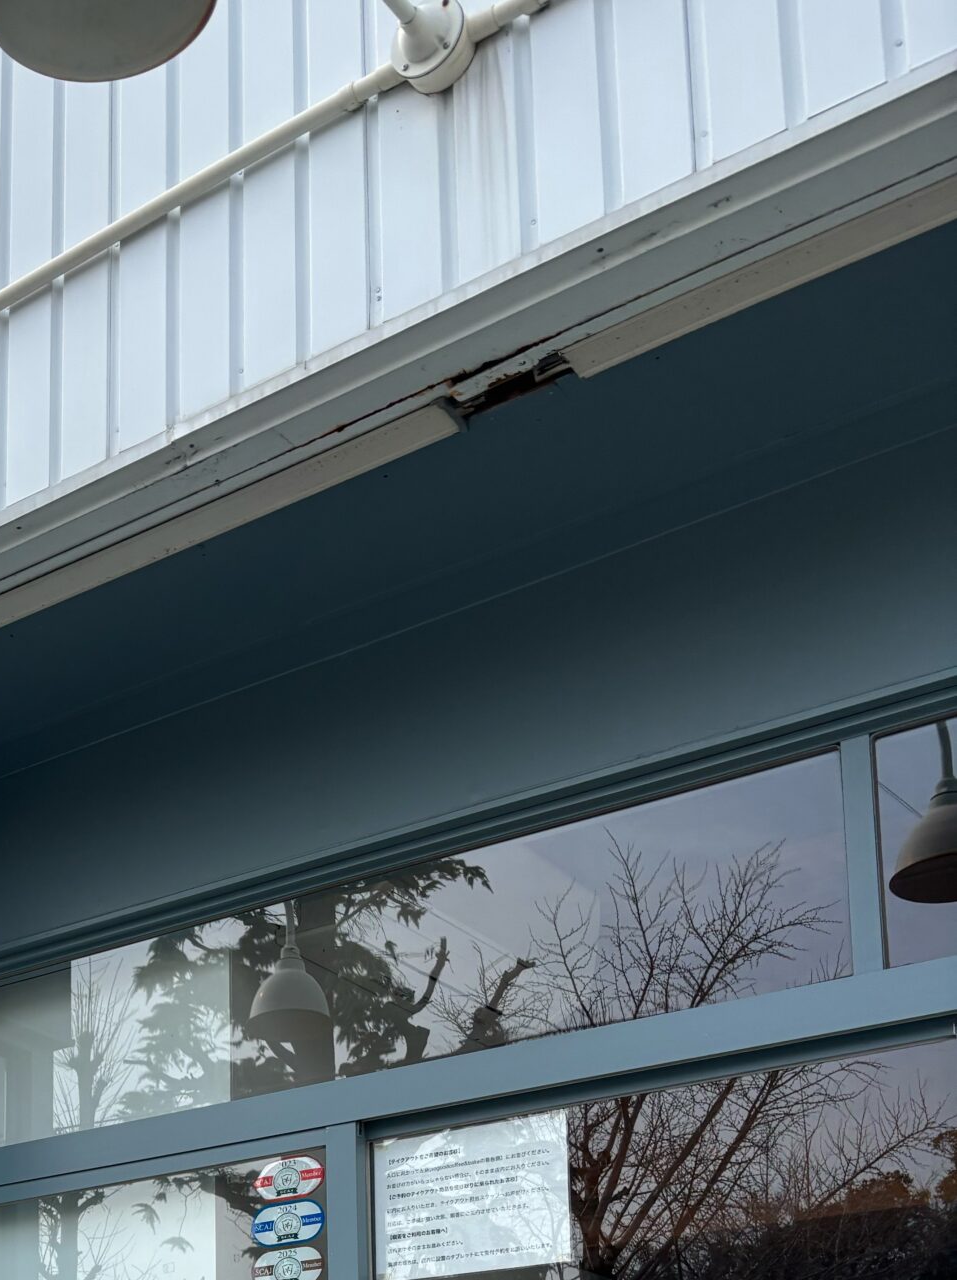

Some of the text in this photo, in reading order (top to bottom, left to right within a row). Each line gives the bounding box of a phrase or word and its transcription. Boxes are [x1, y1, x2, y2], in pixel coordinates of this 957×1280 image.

[278, 1204, 297, 1214] 2024
[255, 1222, 273, 1232] SCAJ
[278, 1249, 297, 1259] 2025
[255, 1266, 272, 1276] SCAJ
